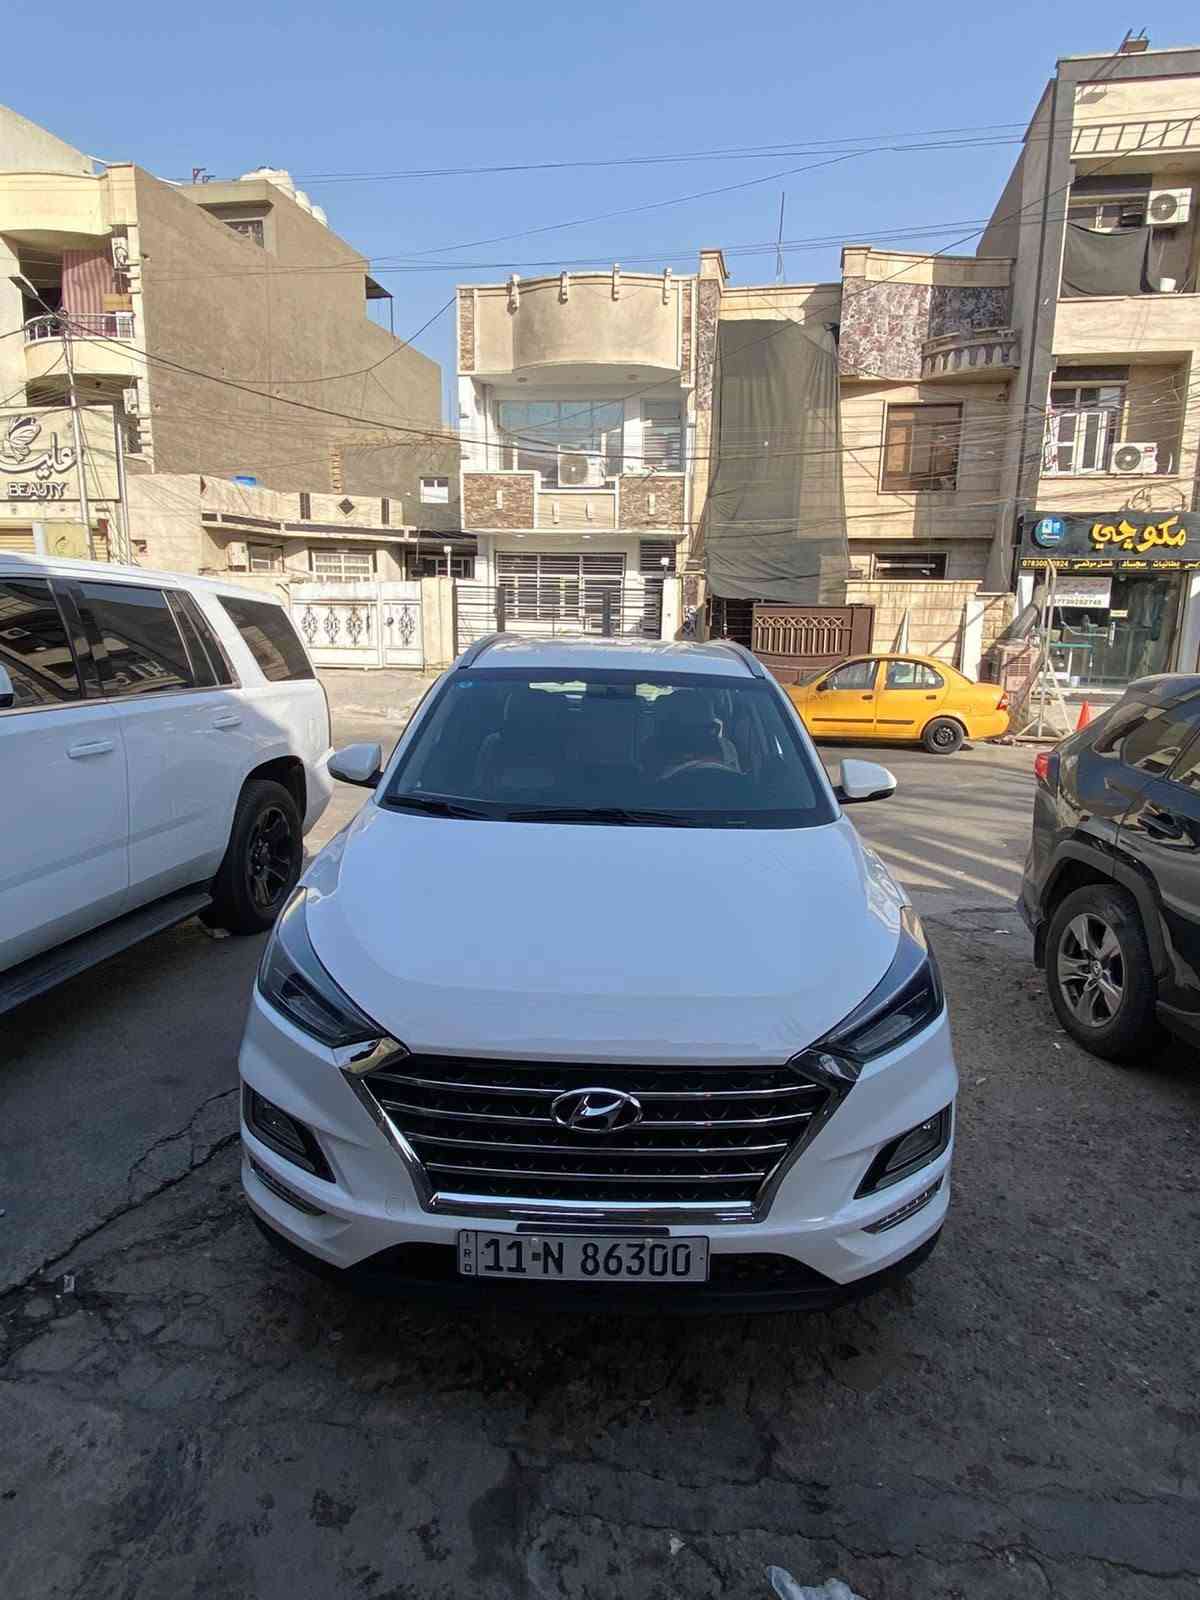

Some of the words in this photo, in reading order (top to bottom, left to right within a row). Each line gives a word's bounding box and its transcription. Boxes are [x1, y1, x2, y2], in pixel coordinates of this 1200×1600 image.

[8, 481, 66, 497] BEAUTY
[483, 1238, 527, 1273] 11
[541, 1241, 565, 1275] N
[580, 1242, 691, 1276] 86300
